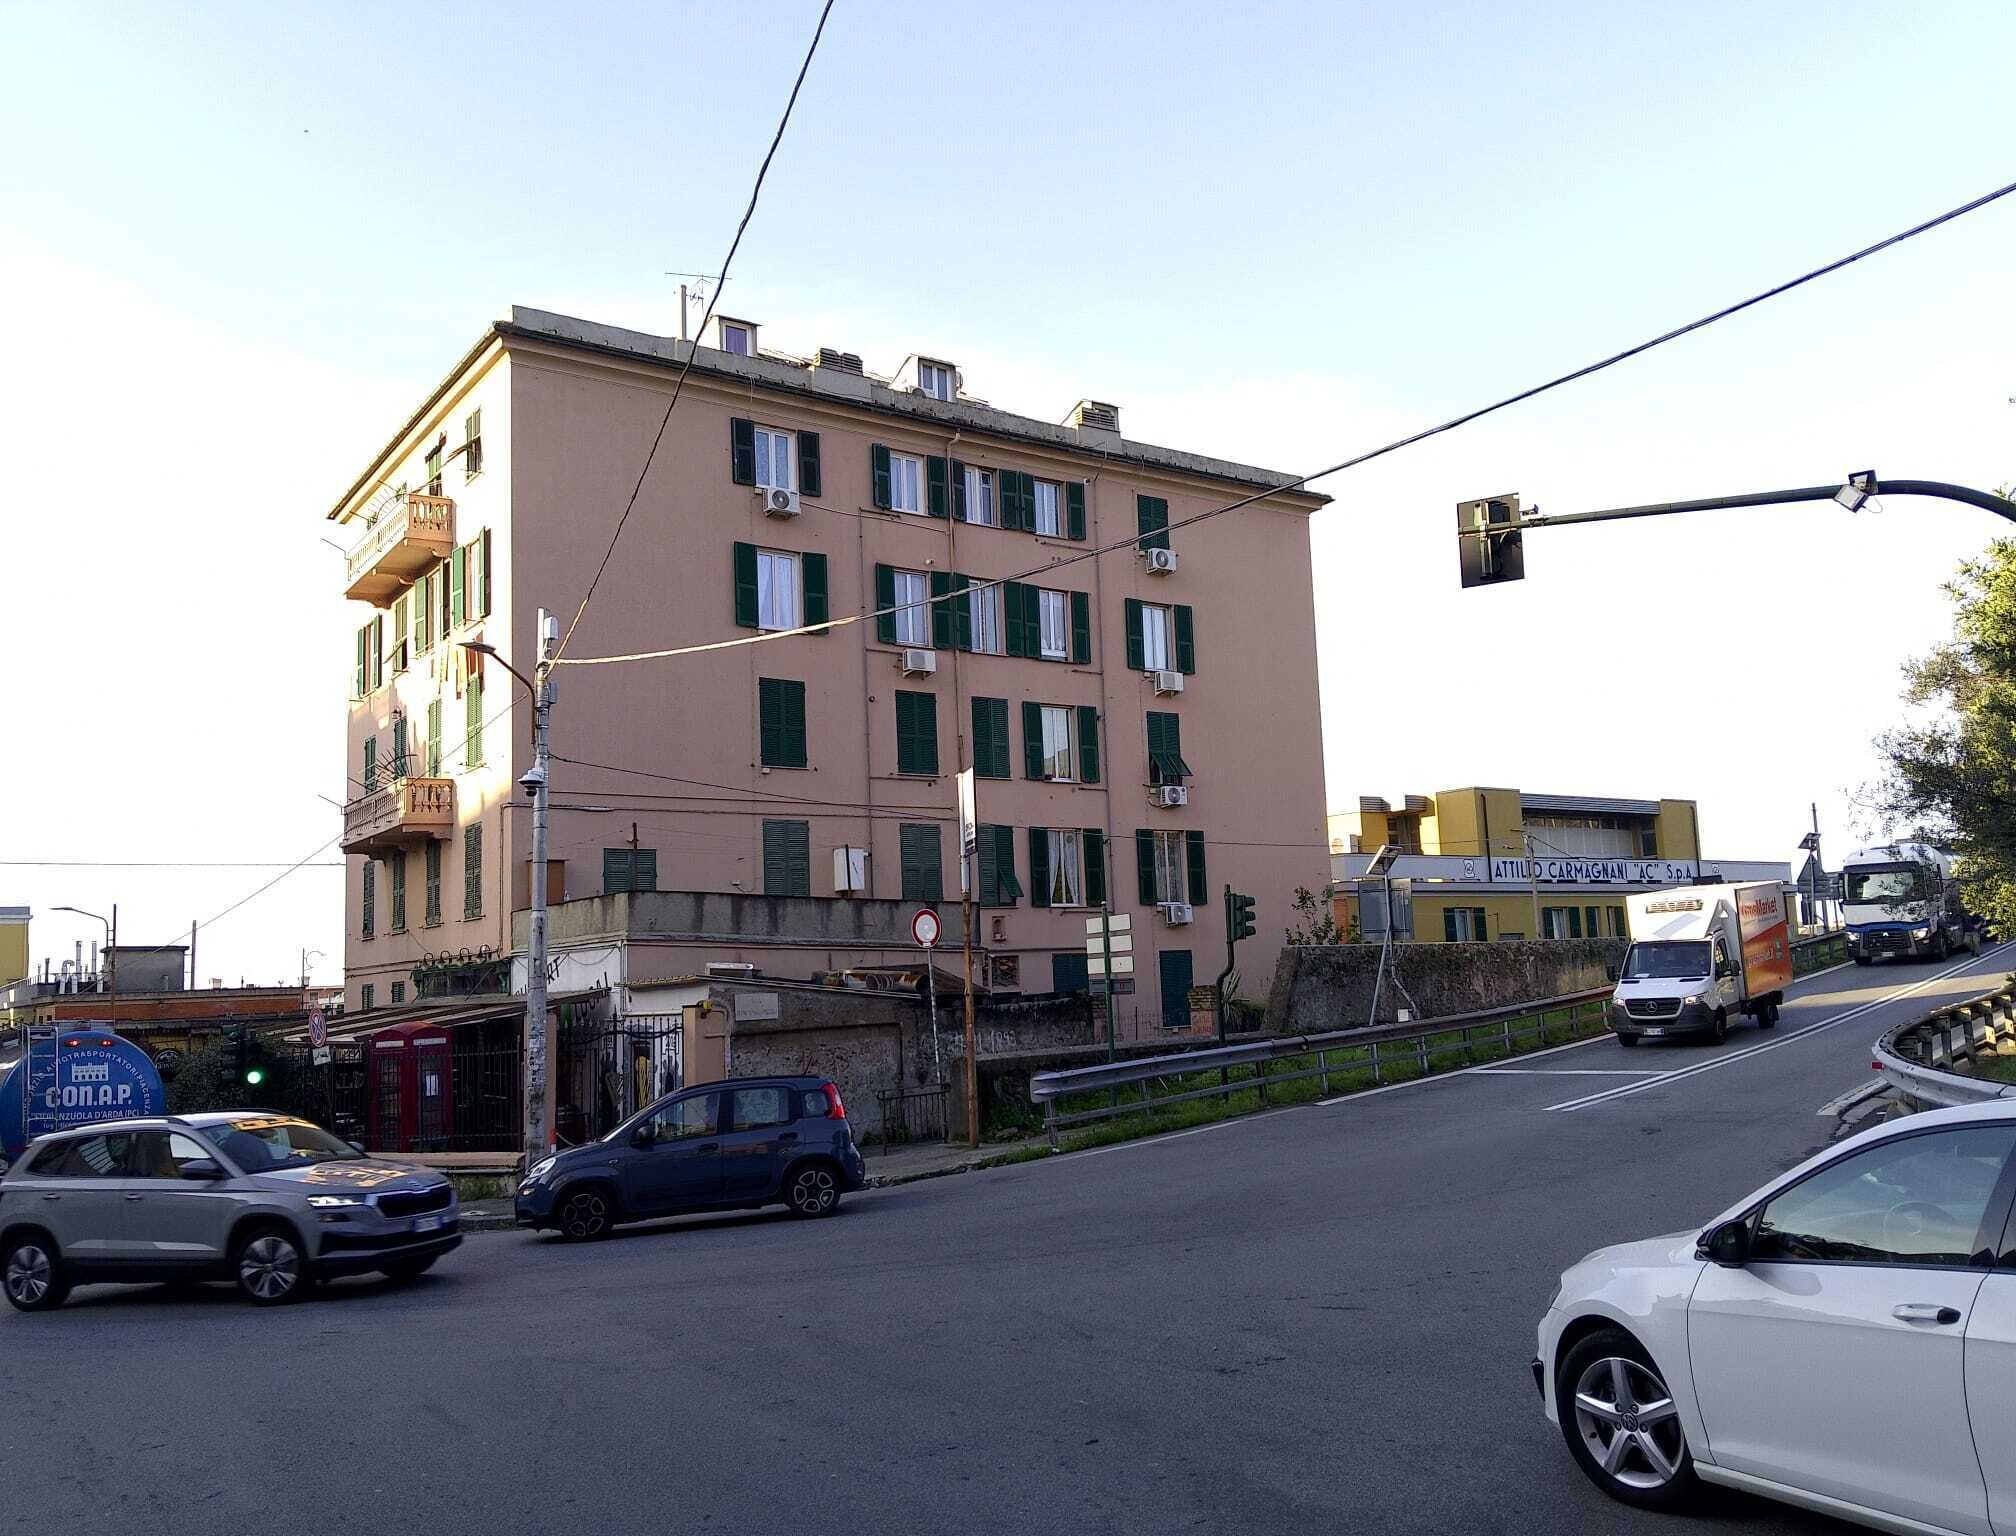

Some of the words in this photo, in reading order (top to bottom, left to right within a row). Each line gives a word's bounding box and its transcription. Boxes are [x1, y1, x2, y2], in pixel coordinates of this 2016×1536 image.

[1548, 862, 1628, 880] CARMAGNANI
[1634, 863, 1659, 880] "AC"
[95, 1109, 123, 1120] D'ARDA
